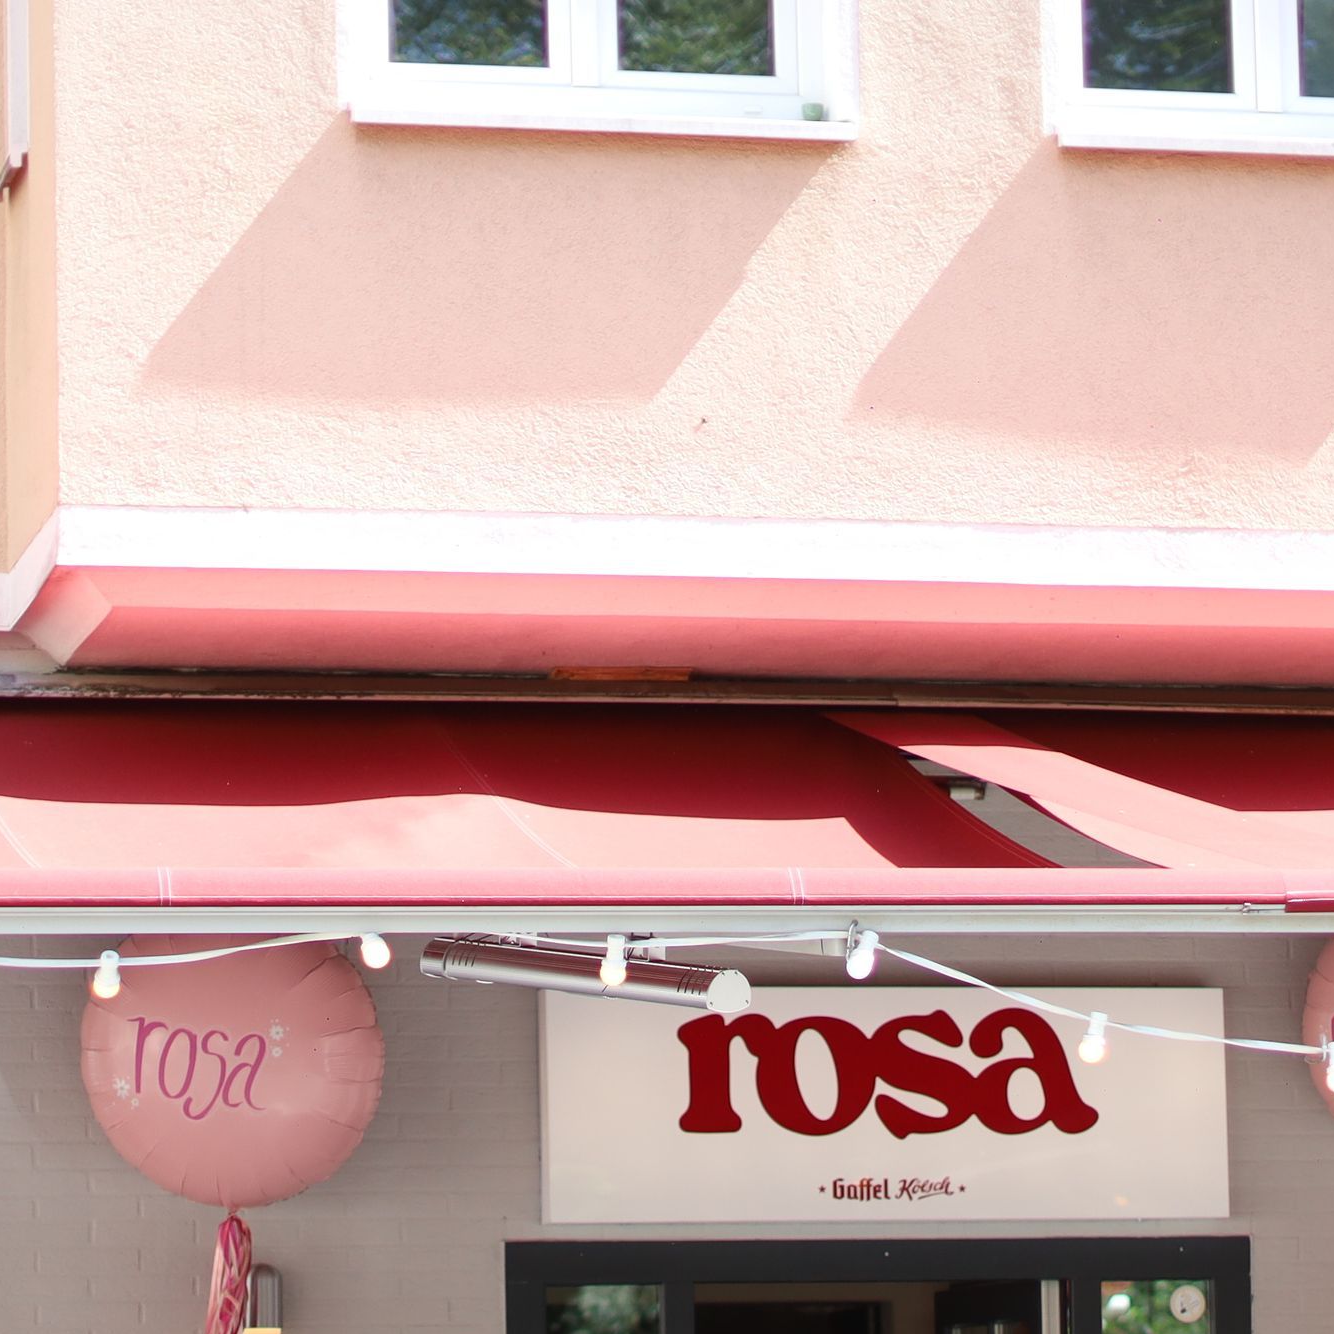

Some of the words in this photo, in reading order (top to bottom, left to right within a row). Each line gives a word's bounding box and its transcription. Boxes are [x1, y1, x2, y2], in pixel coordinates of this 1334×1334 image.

[126, 1016, 267, 1120] rosa
[677, 1007, 1099, 1139] rosa
[831, 1177, 891, 1202] Gaffel
